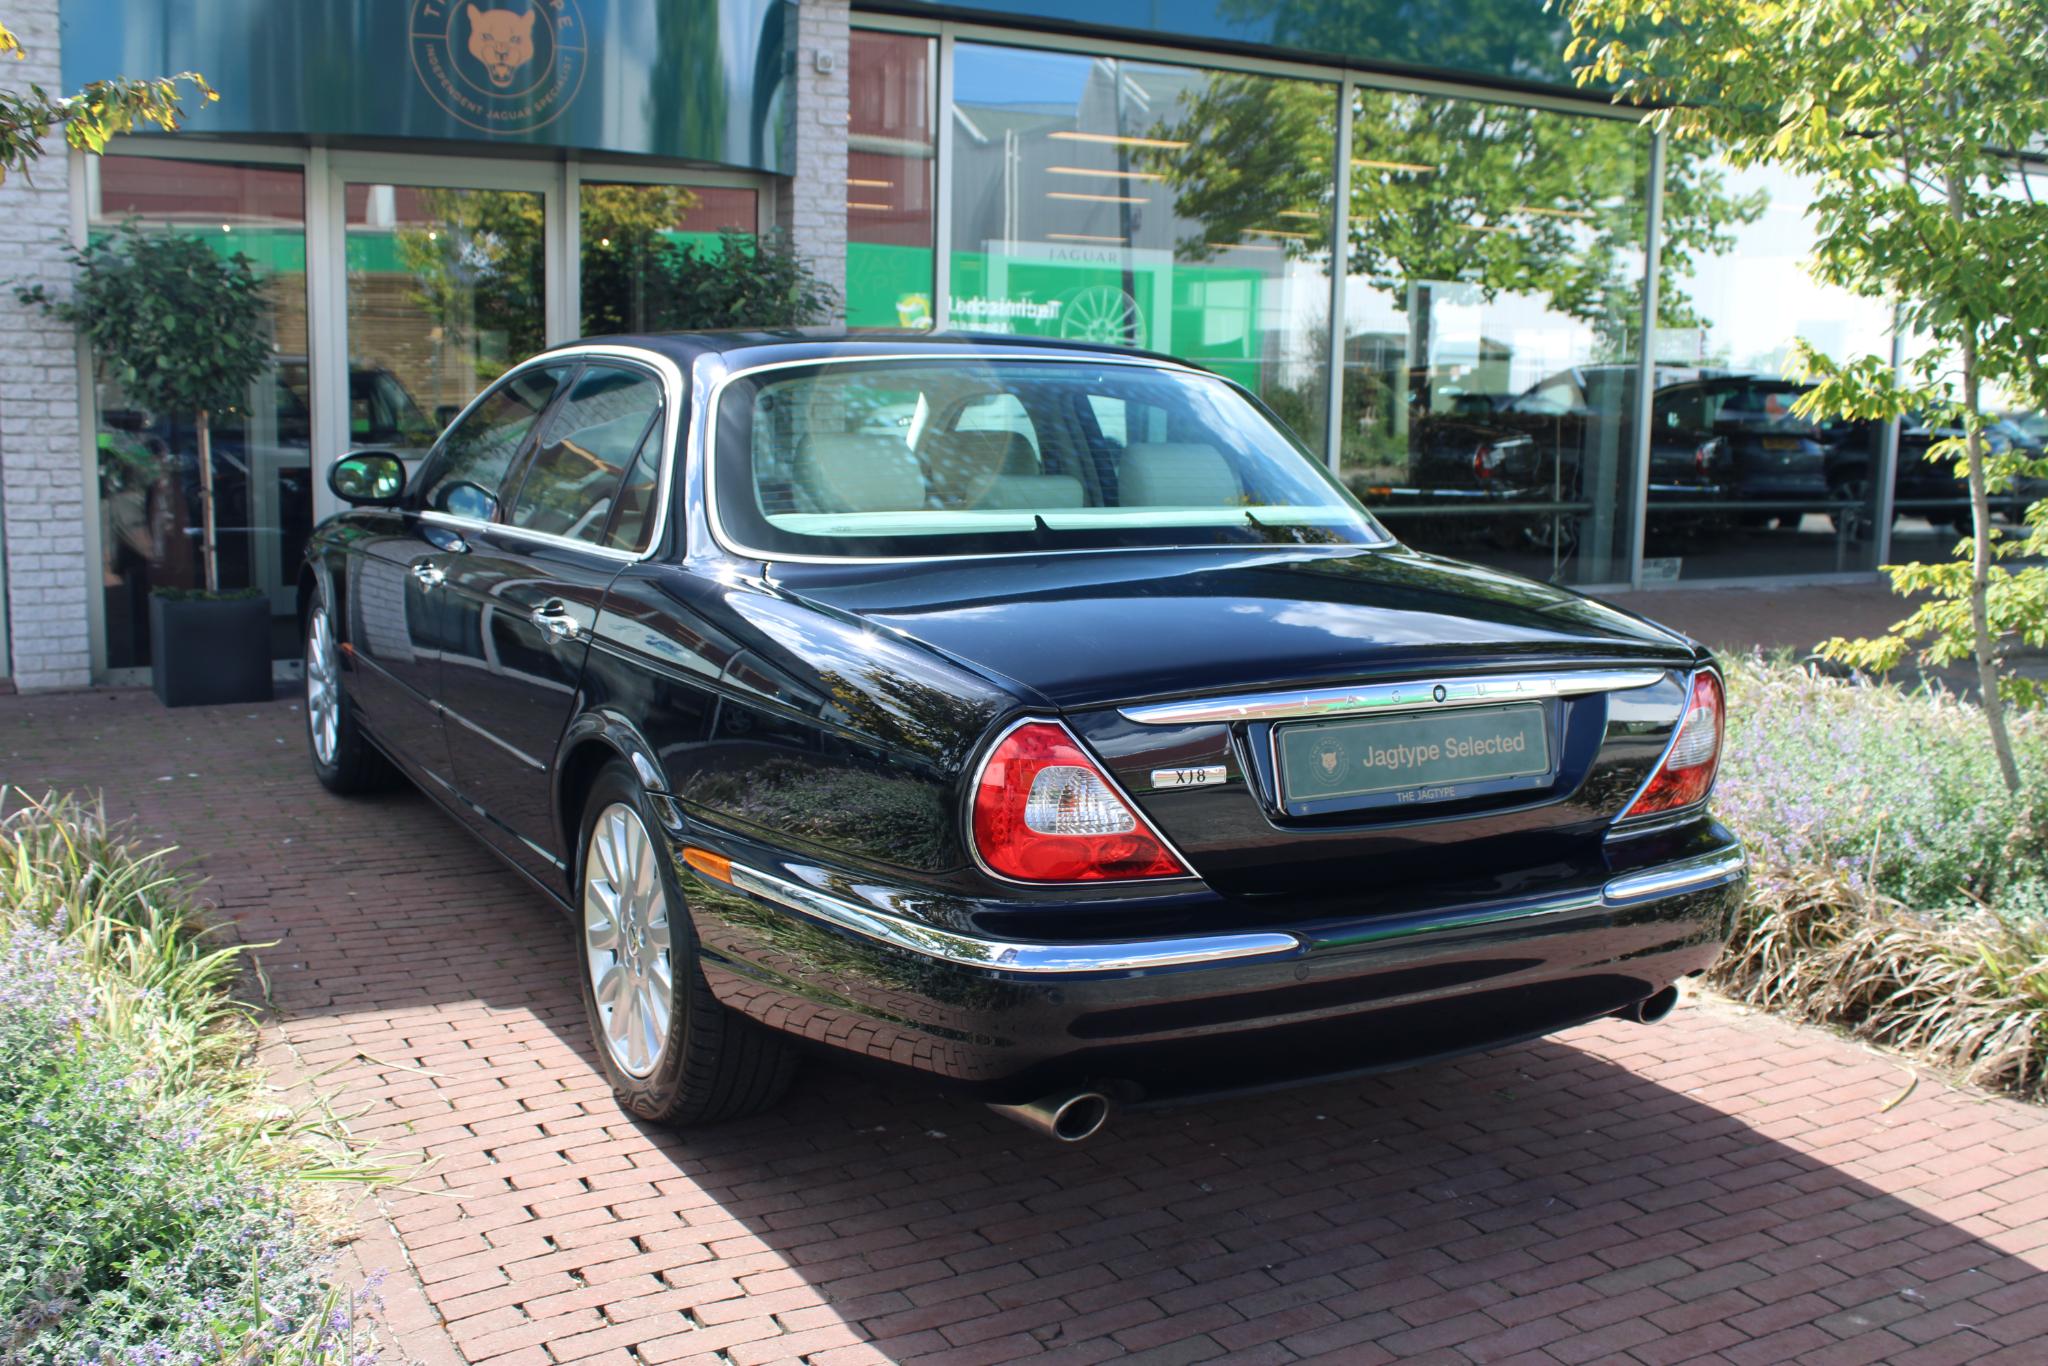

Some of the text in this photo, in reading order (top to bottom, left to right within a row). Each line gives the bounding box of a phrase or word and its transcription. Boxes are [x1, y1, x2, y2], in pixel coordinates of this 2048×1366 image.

[426, 44, 572, 120] INDEPENDENT JAGUAR SPECIALIST
[1049, 248, 1117, 264] JAGUAR
[1363, 744, 1440, 770] Jagtype
[1445, 731, 1525, 758] Selected
[1175, 768, 1206, 784] XJ8
[1396, 786, 1456, 803] THE JAGTYPE
